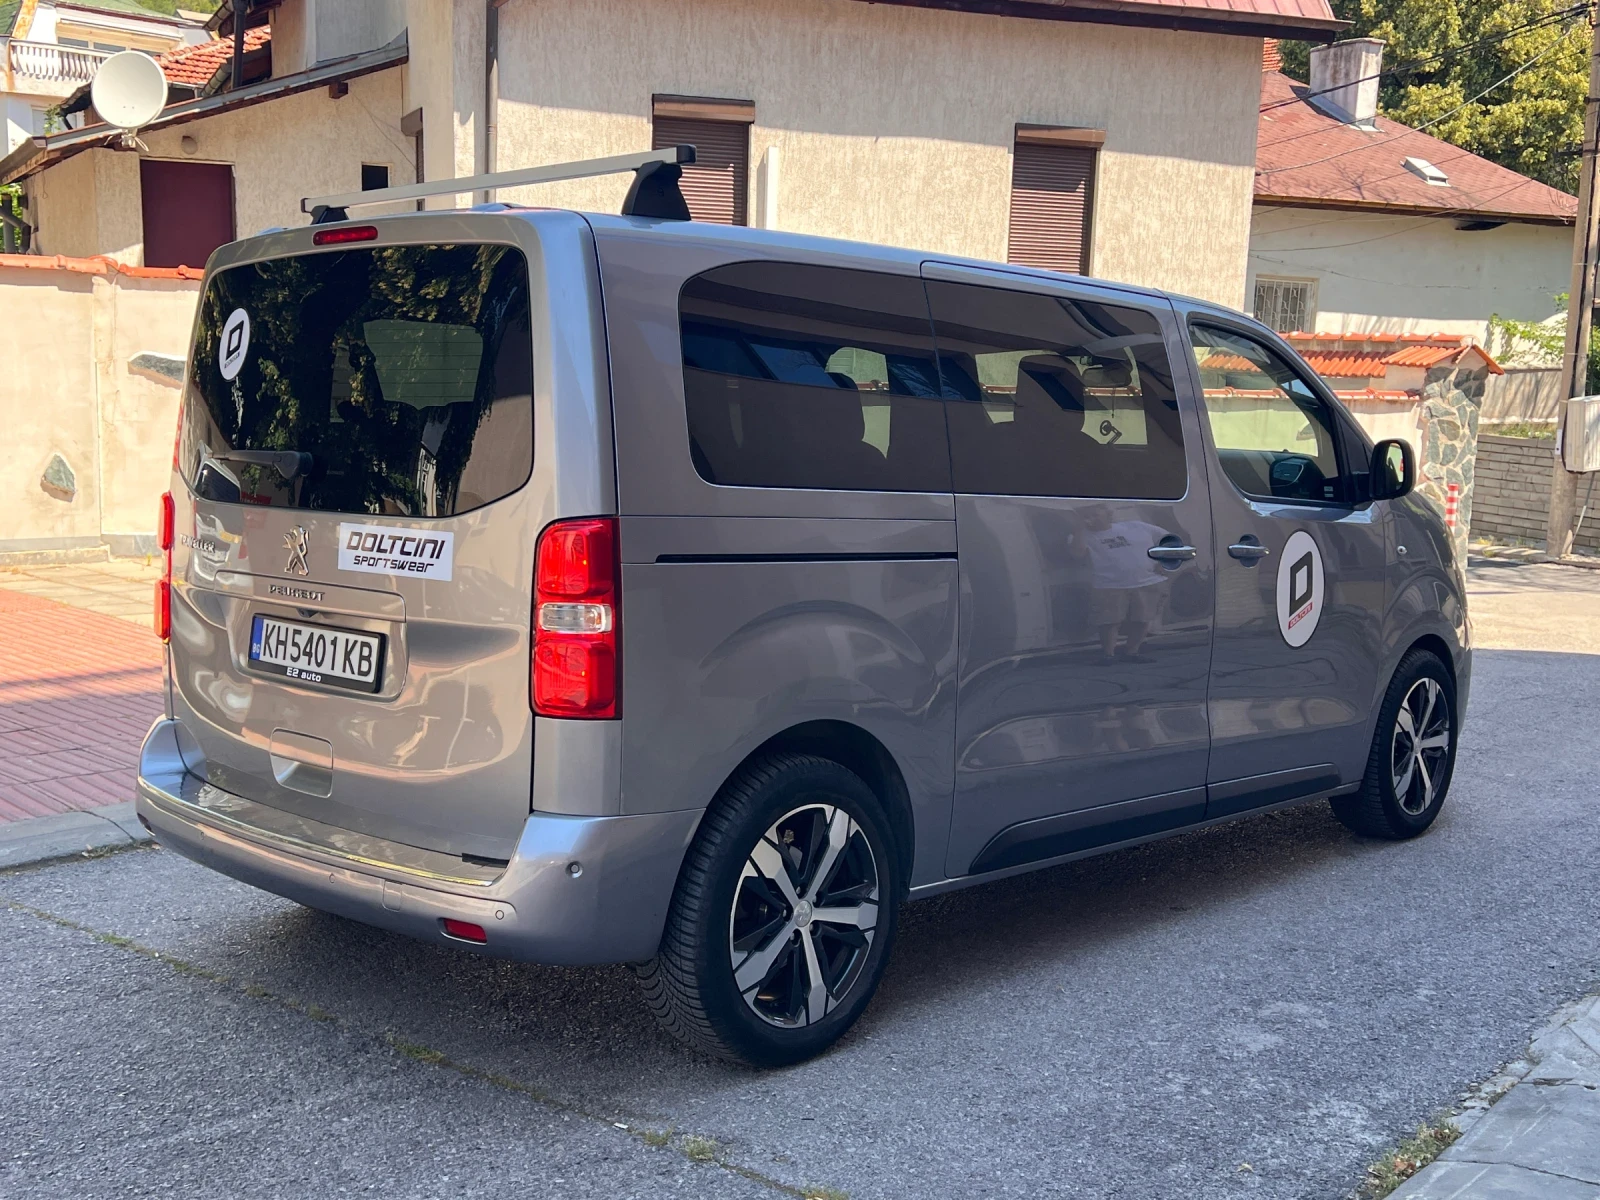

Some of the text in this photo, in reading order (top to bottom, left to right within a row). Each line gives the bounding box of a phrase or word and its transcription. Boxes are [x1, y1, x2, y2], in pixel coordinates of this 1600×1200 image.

[346, 531, 446, 559] DOLTCINI
[262, 623, 373, 677] KH5401KB
[286, 666, 322, 682] E2 auto
